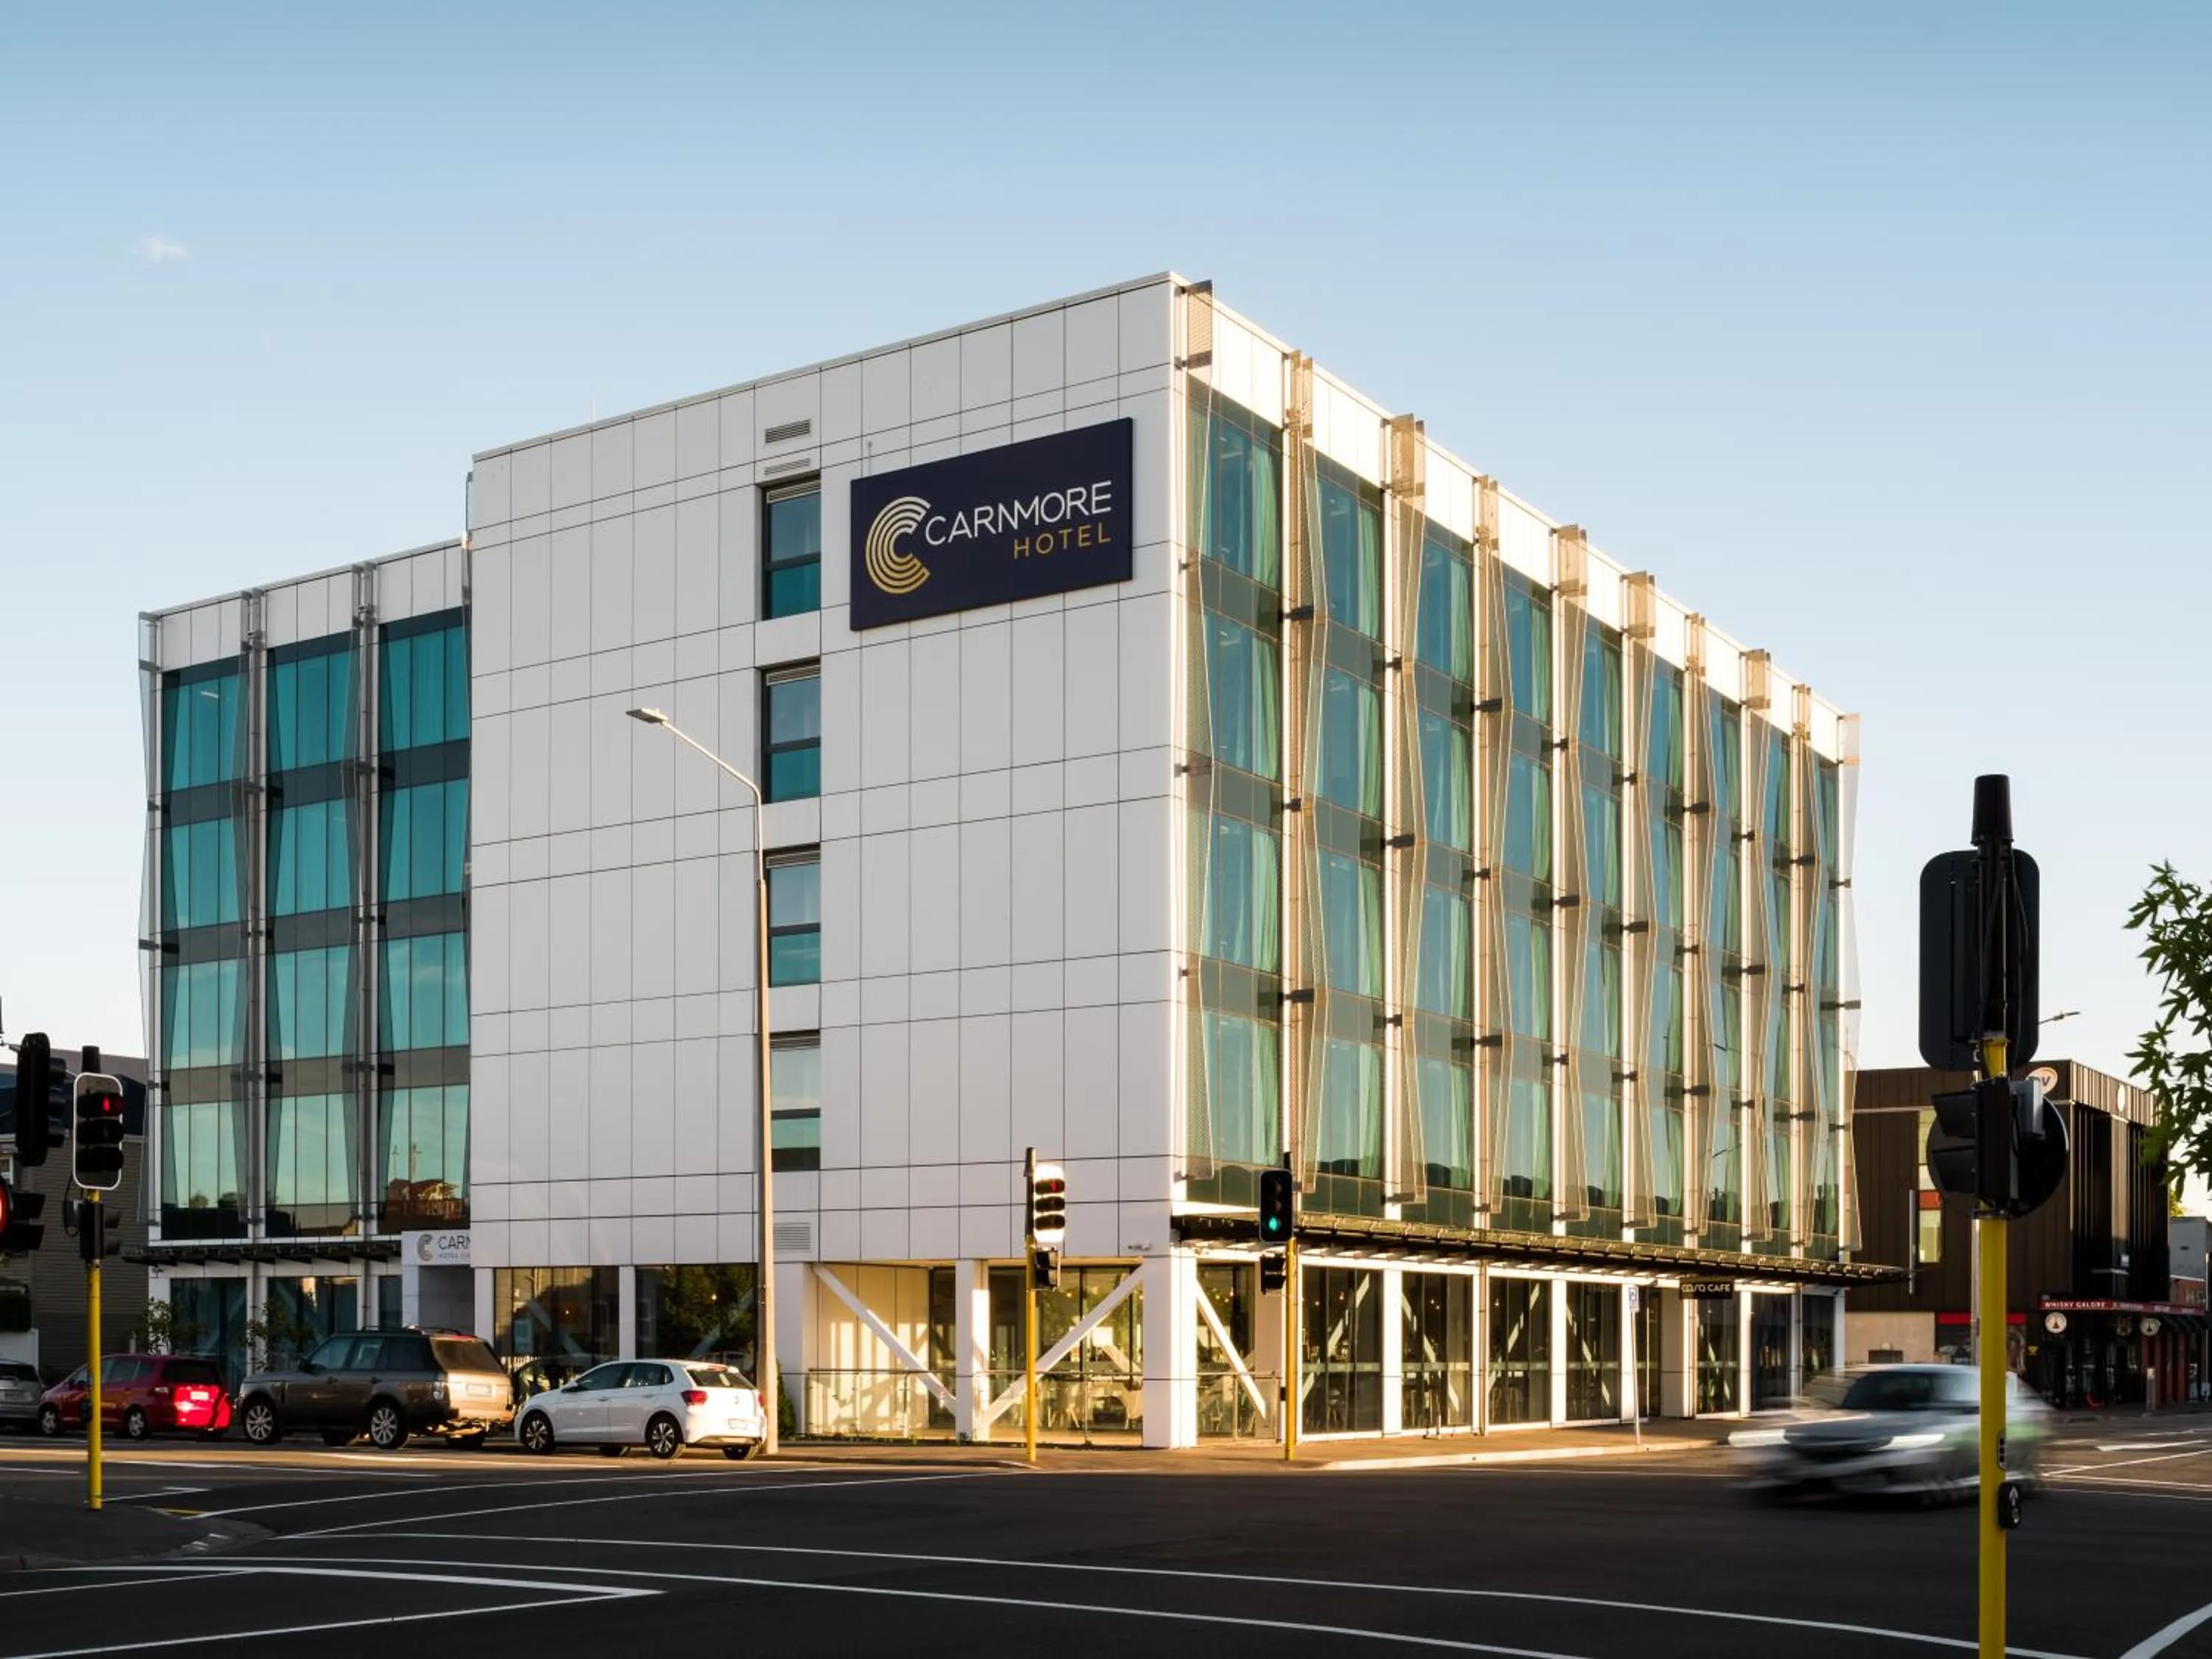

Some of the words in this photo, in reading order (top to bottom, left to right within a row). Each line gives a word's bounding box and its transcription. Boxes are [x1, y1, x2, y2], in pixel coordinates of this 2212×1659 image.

[925, 480, 1111, 545] CARNMORE
[1013, 522, 1111, 559] HOTEL
[1707, 1284, 1731, 1292] CAFE
